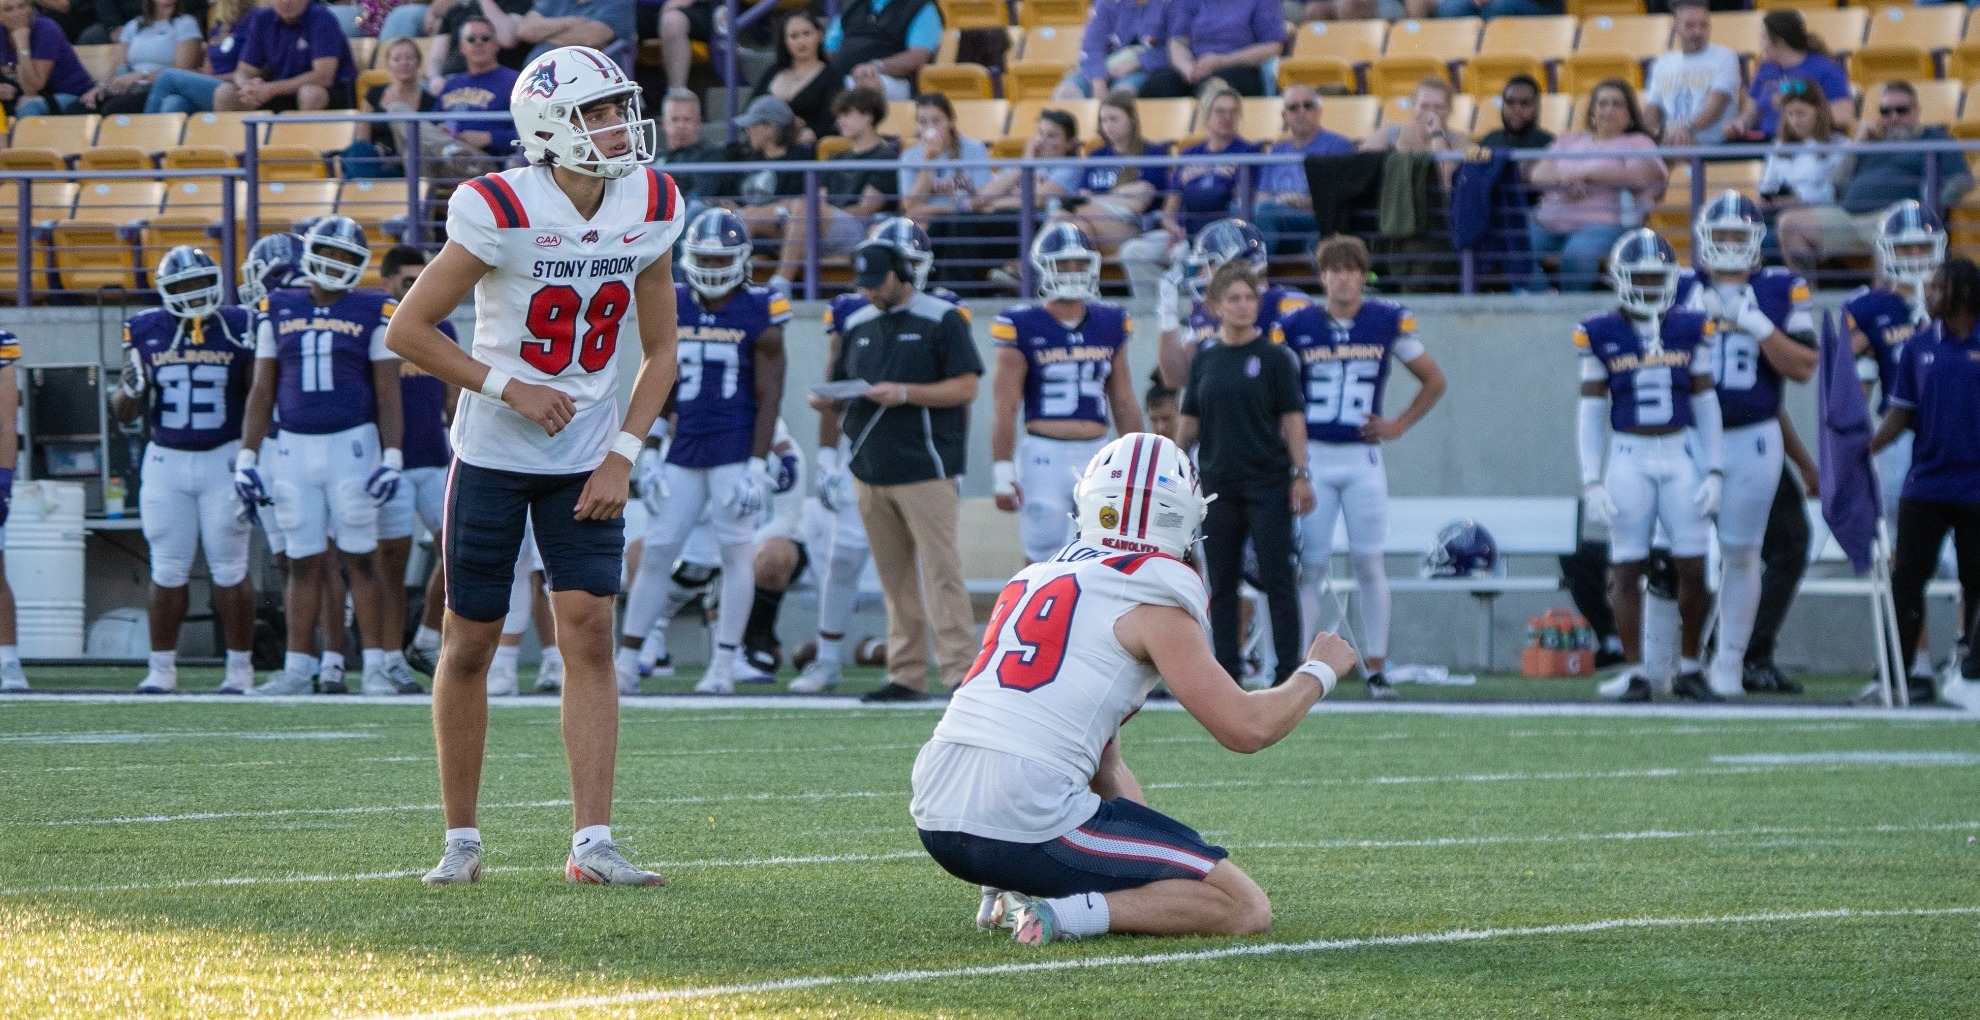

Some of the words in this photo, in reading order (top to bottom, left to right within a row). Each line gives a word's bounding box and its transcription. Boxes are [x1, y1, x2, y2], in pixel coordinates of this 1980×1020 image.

[533, 260, 587, 278] STONY
[590, 256, 637, 278] BROOK
[536, 236, 558, 244] CAA
[519, 279, 631, 376] 98
[301, 330, 334, 392] 11
[1042, 361, 1112, 417] 34
[1304, 360, 1380, 427] 36
[1635, 366, 1673, 425] 3
[1111, 470, 1122, 478] 99
[1102, 537, 1159, 553] SEAWOLVES
[961, 572, 1082, 693] 99
